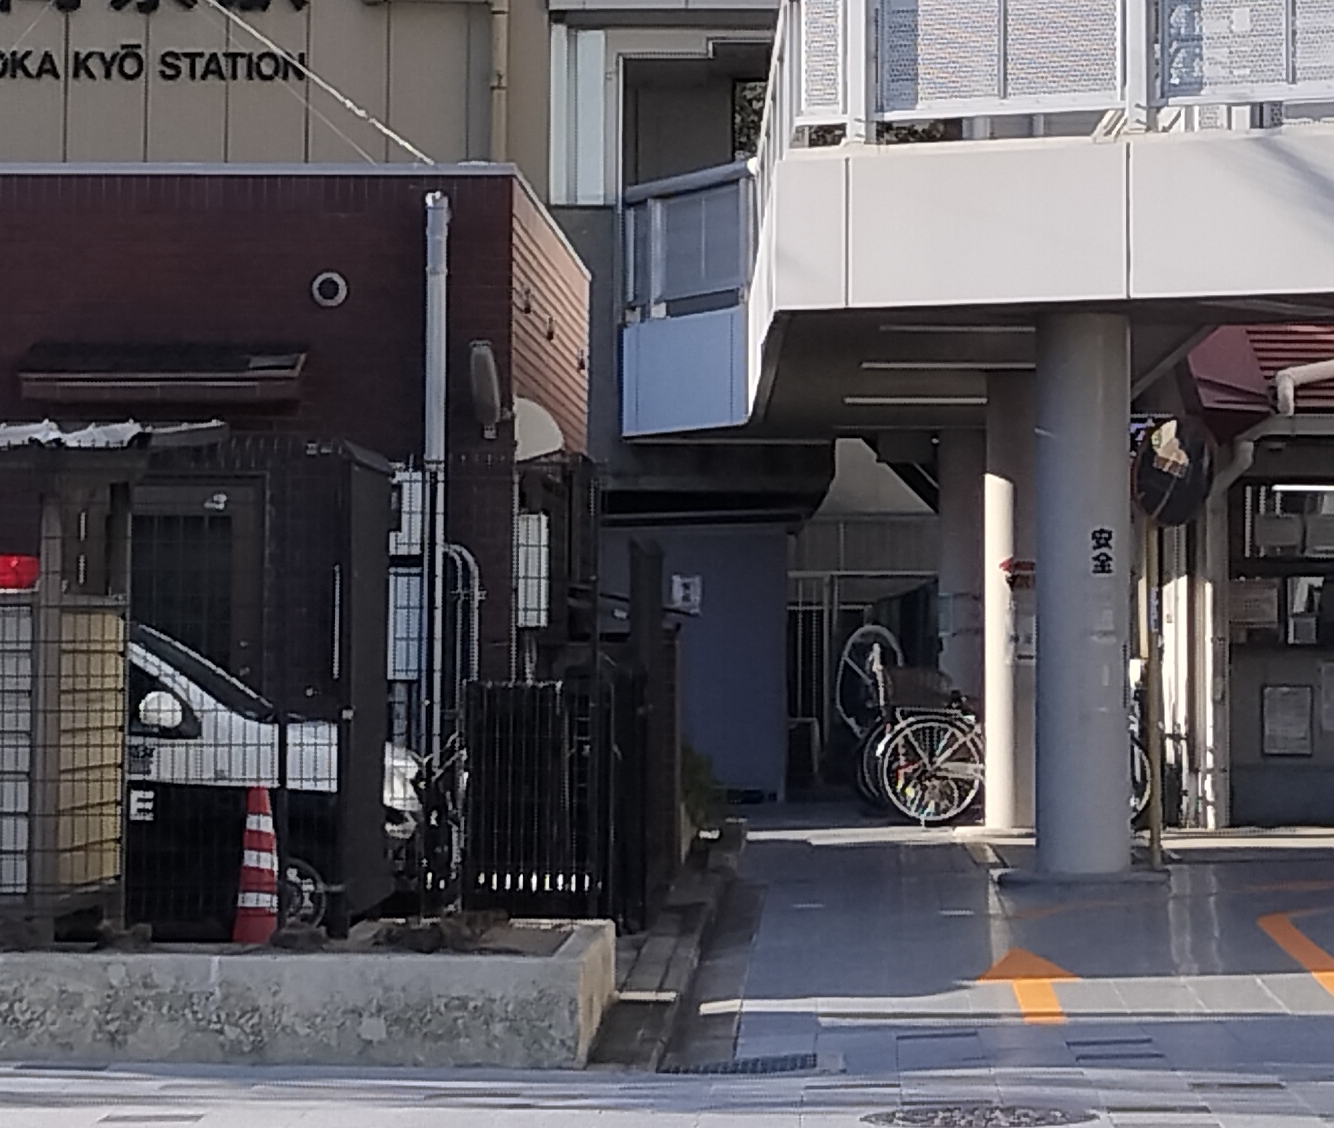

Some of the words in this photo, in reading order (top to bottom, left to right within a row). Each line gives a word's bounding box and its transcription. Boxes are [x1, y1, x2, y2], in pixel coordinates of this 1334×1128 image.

[73, 44, 144, 80] KYŌ
[159, 51, 306, 81] STATION
[1091, 528, 1113, 574] 安全
